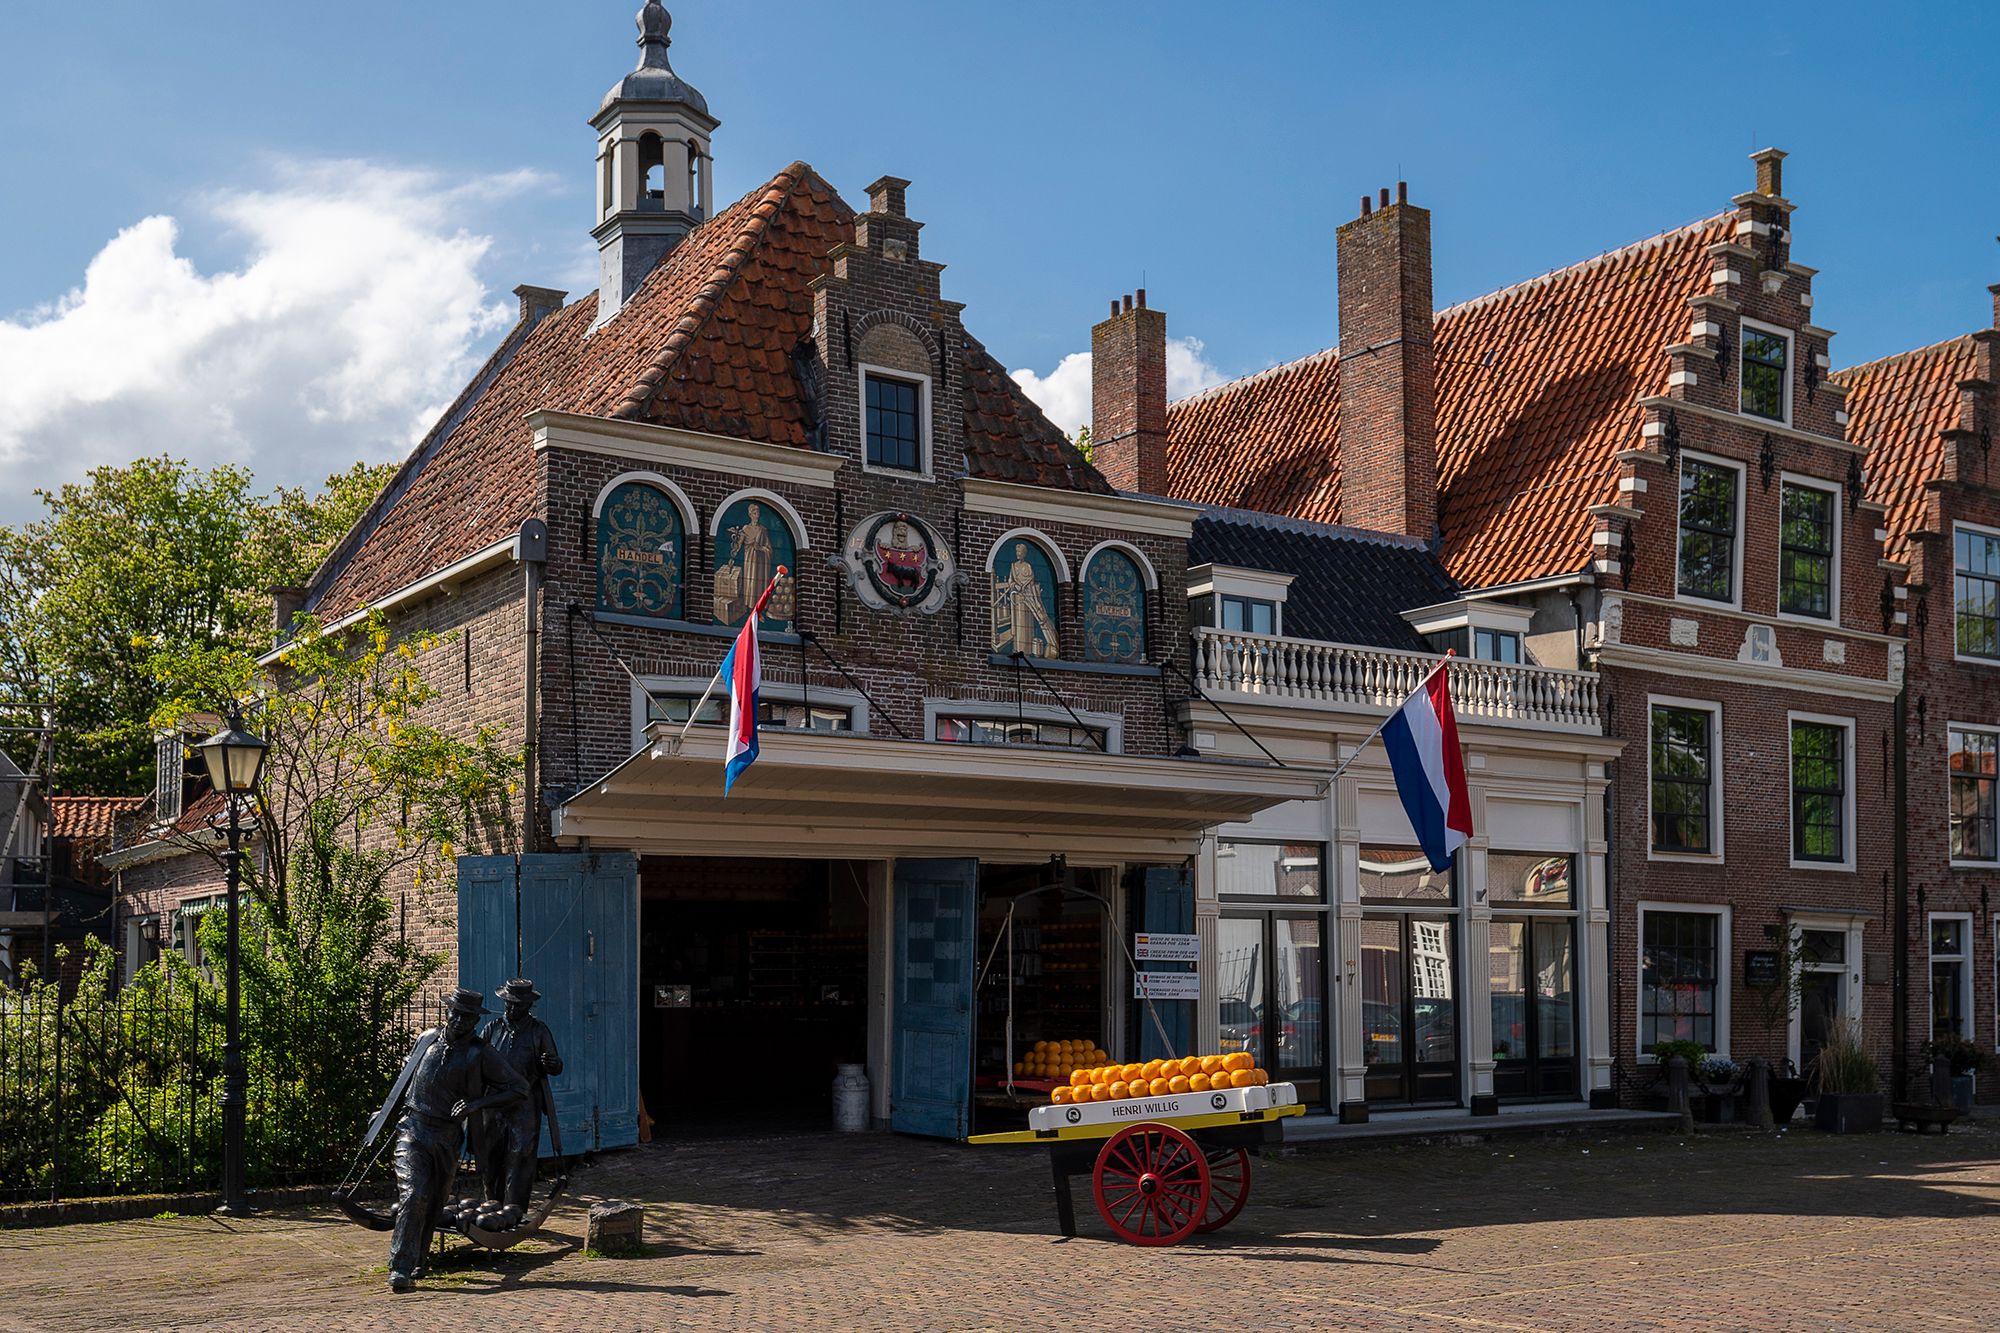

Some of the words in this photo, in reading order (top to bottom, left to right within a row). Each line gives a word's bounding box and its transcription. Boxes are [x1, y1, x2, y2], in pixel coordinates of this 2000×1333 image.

[619, 549, 660, 564] HANDEL
[1348, 973, 1355, 985] 7
[1112, 1105, 1142, 1117] HENRI
[1145, 1101, 1179, 1113] WILLIG
